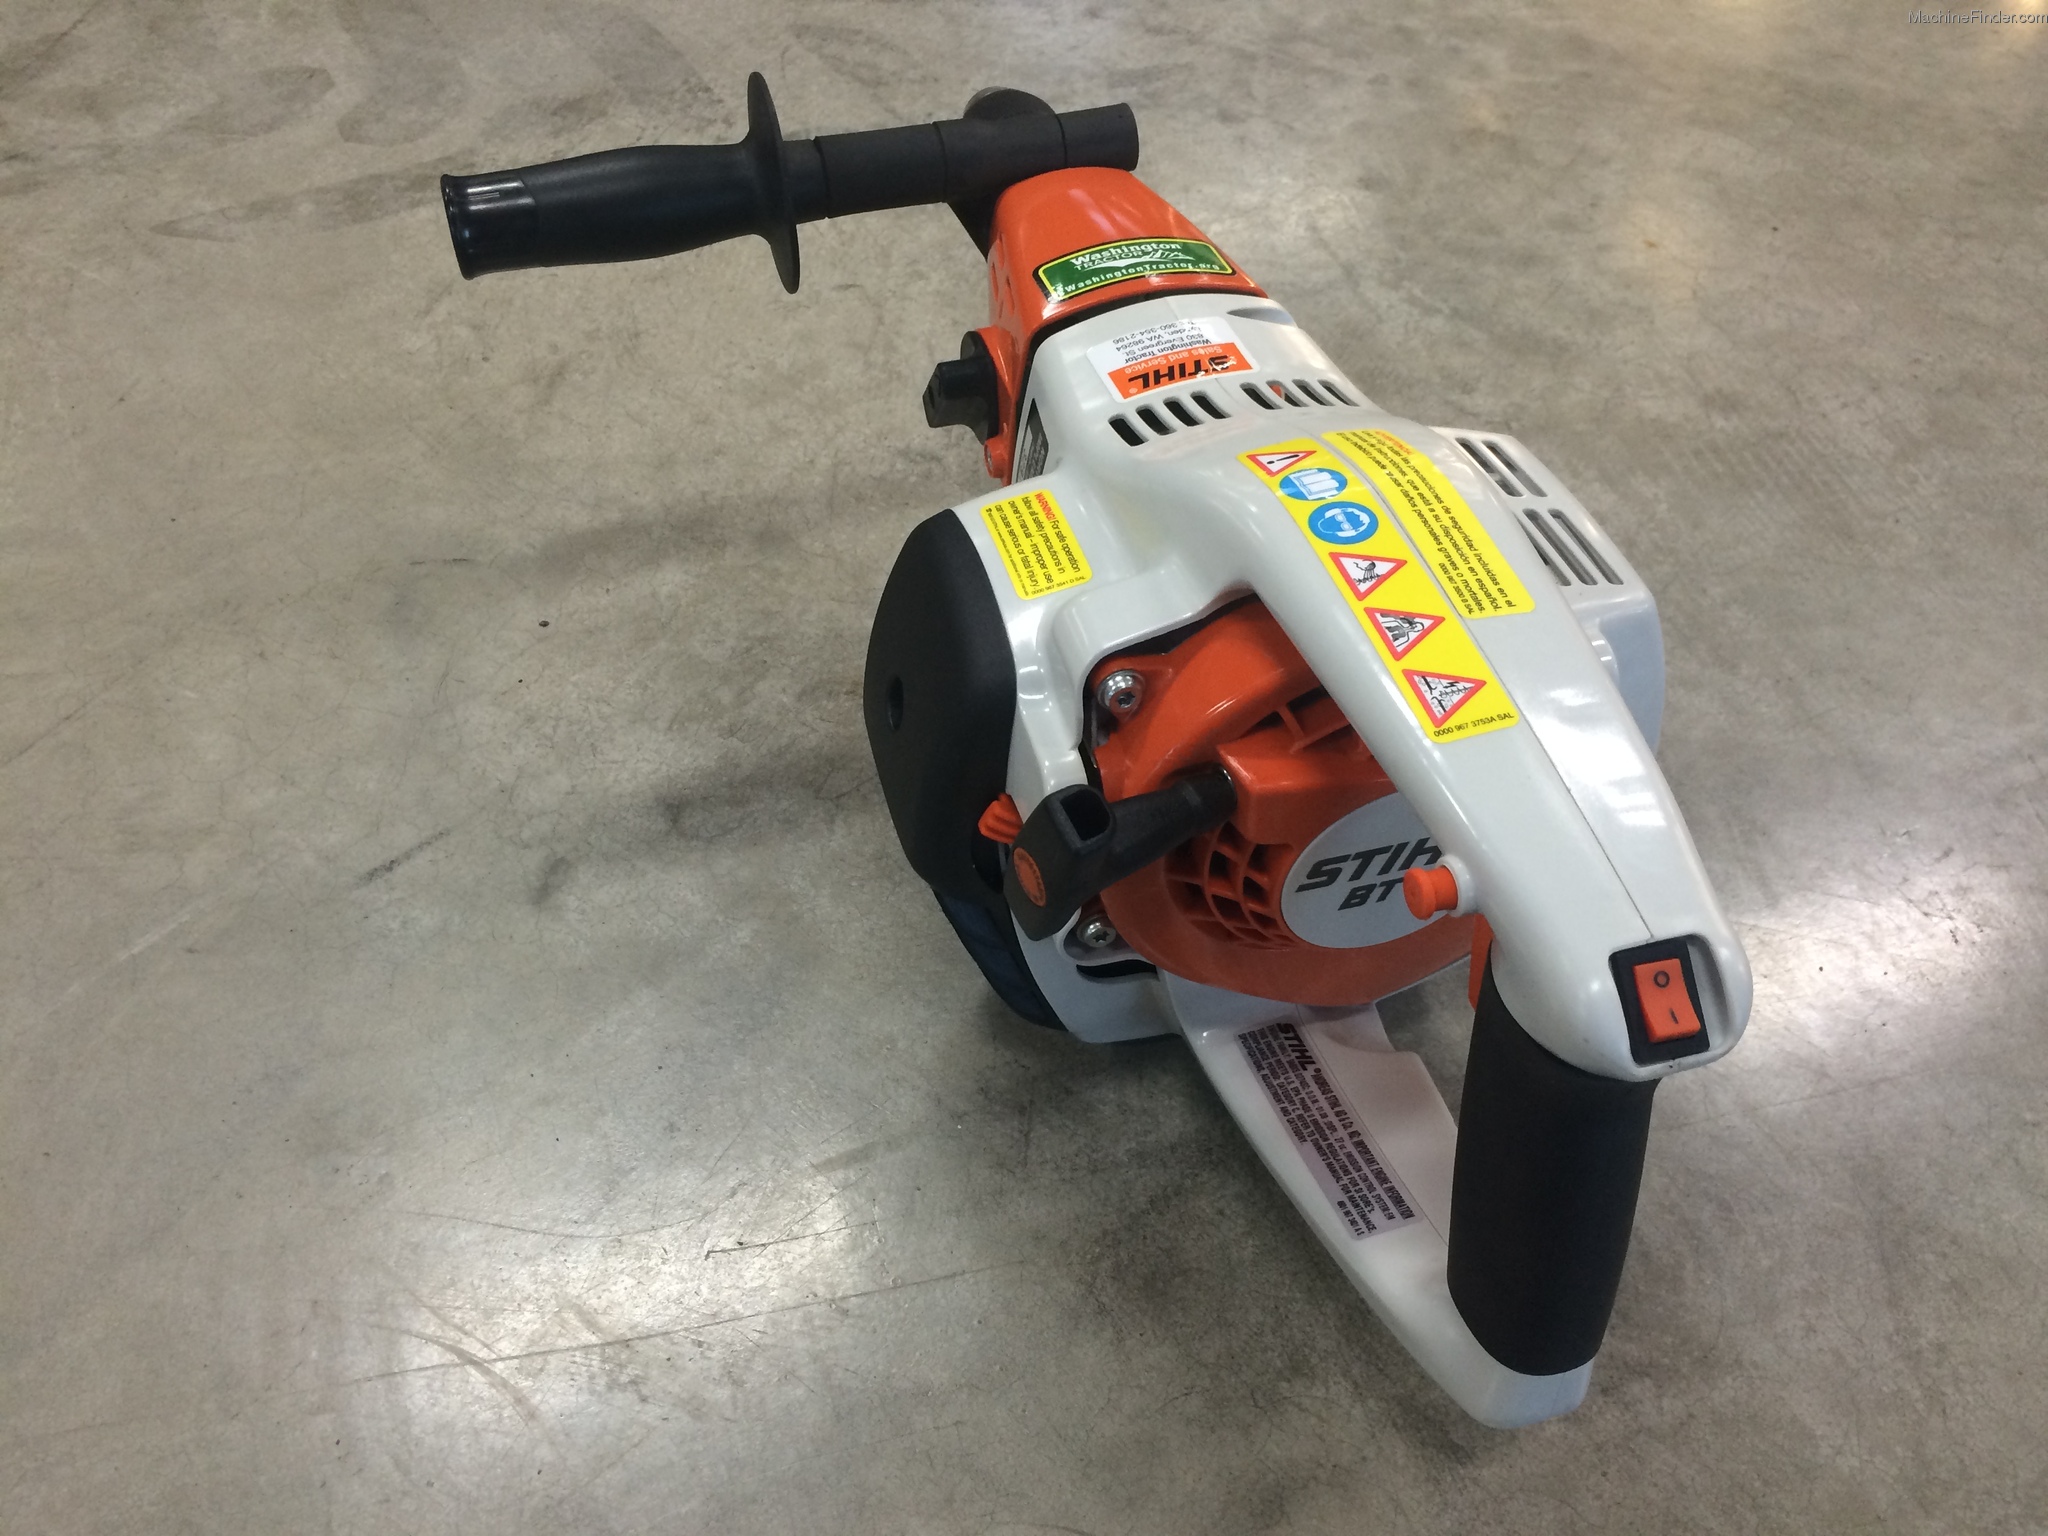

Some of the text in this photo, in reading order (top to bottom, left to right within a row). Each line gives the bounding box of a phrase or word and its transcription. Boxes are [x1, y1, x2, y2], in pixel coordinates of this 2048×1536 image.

[1070, 242, 1182, 266] Washington
[1074, 251, 1144, 271] TRACTOR
[1116, 339, 1145, 351] 98264
[1138, 336, 1184, 352] Evergreen
[1148, 334, 1163, 342] WA
[1188, 334, 1204, 342] 830
[1125, 339, 1211, 363] Washington Tractor
[1125, 346, 1222, 374] Sales and Service
[1128, 355, 1229, 389] STIHL
[995, 504, 1004, 513] can
[999, 513, 1011, 528] cause
[1007, 528, 1022, 548] serious
[1008, 500, 1023, 518] owner's
[1018, 519, 1033, 538] manual
[1028, 543, 1048, 570] improper
[1043, 571, 1053, 583] use
[1021, 496, 1034, 509] follow
[1031, 516, 1046, 533] safety
[1039, 532, 1062, 566] precautions
[1035, 492, 1081, 572] WARNING! For safe operation
[1405, 479, 1420, 490] que
[1415, 492, 1433, 506] está
[1431, 514, 1443, 522] su
[1438, 524, 1472, 564] disposición
[1466, 566, 1479, 576] en
[1473, 578, 1504, 611] español.
[1440, 505, 1452, 514] de
[1447, 516, 1478, 551] seguridad
[1472, 552, 1501, 586] incluidas
[1496, 587, 1508, 597] en
[1020, 555, 1033, 569] fatal
[1411, 509, 1444, 545] personales
[1435, 547, 1460, 570] graves
[1459, 579, 1490, 613] mortales.
[1433, 726, 1453, 736] 0000
[1454, 722, 1469, 731] 967
[1496, 711, 1514, 720] SAL
[1295, 837, 1442, 892] STIH
[1338, 876, 1404, 911] BT
[1276, 1022, 1316, 1071] STIHL
[1383, 1185, 1414, 1219] INFORMATION
